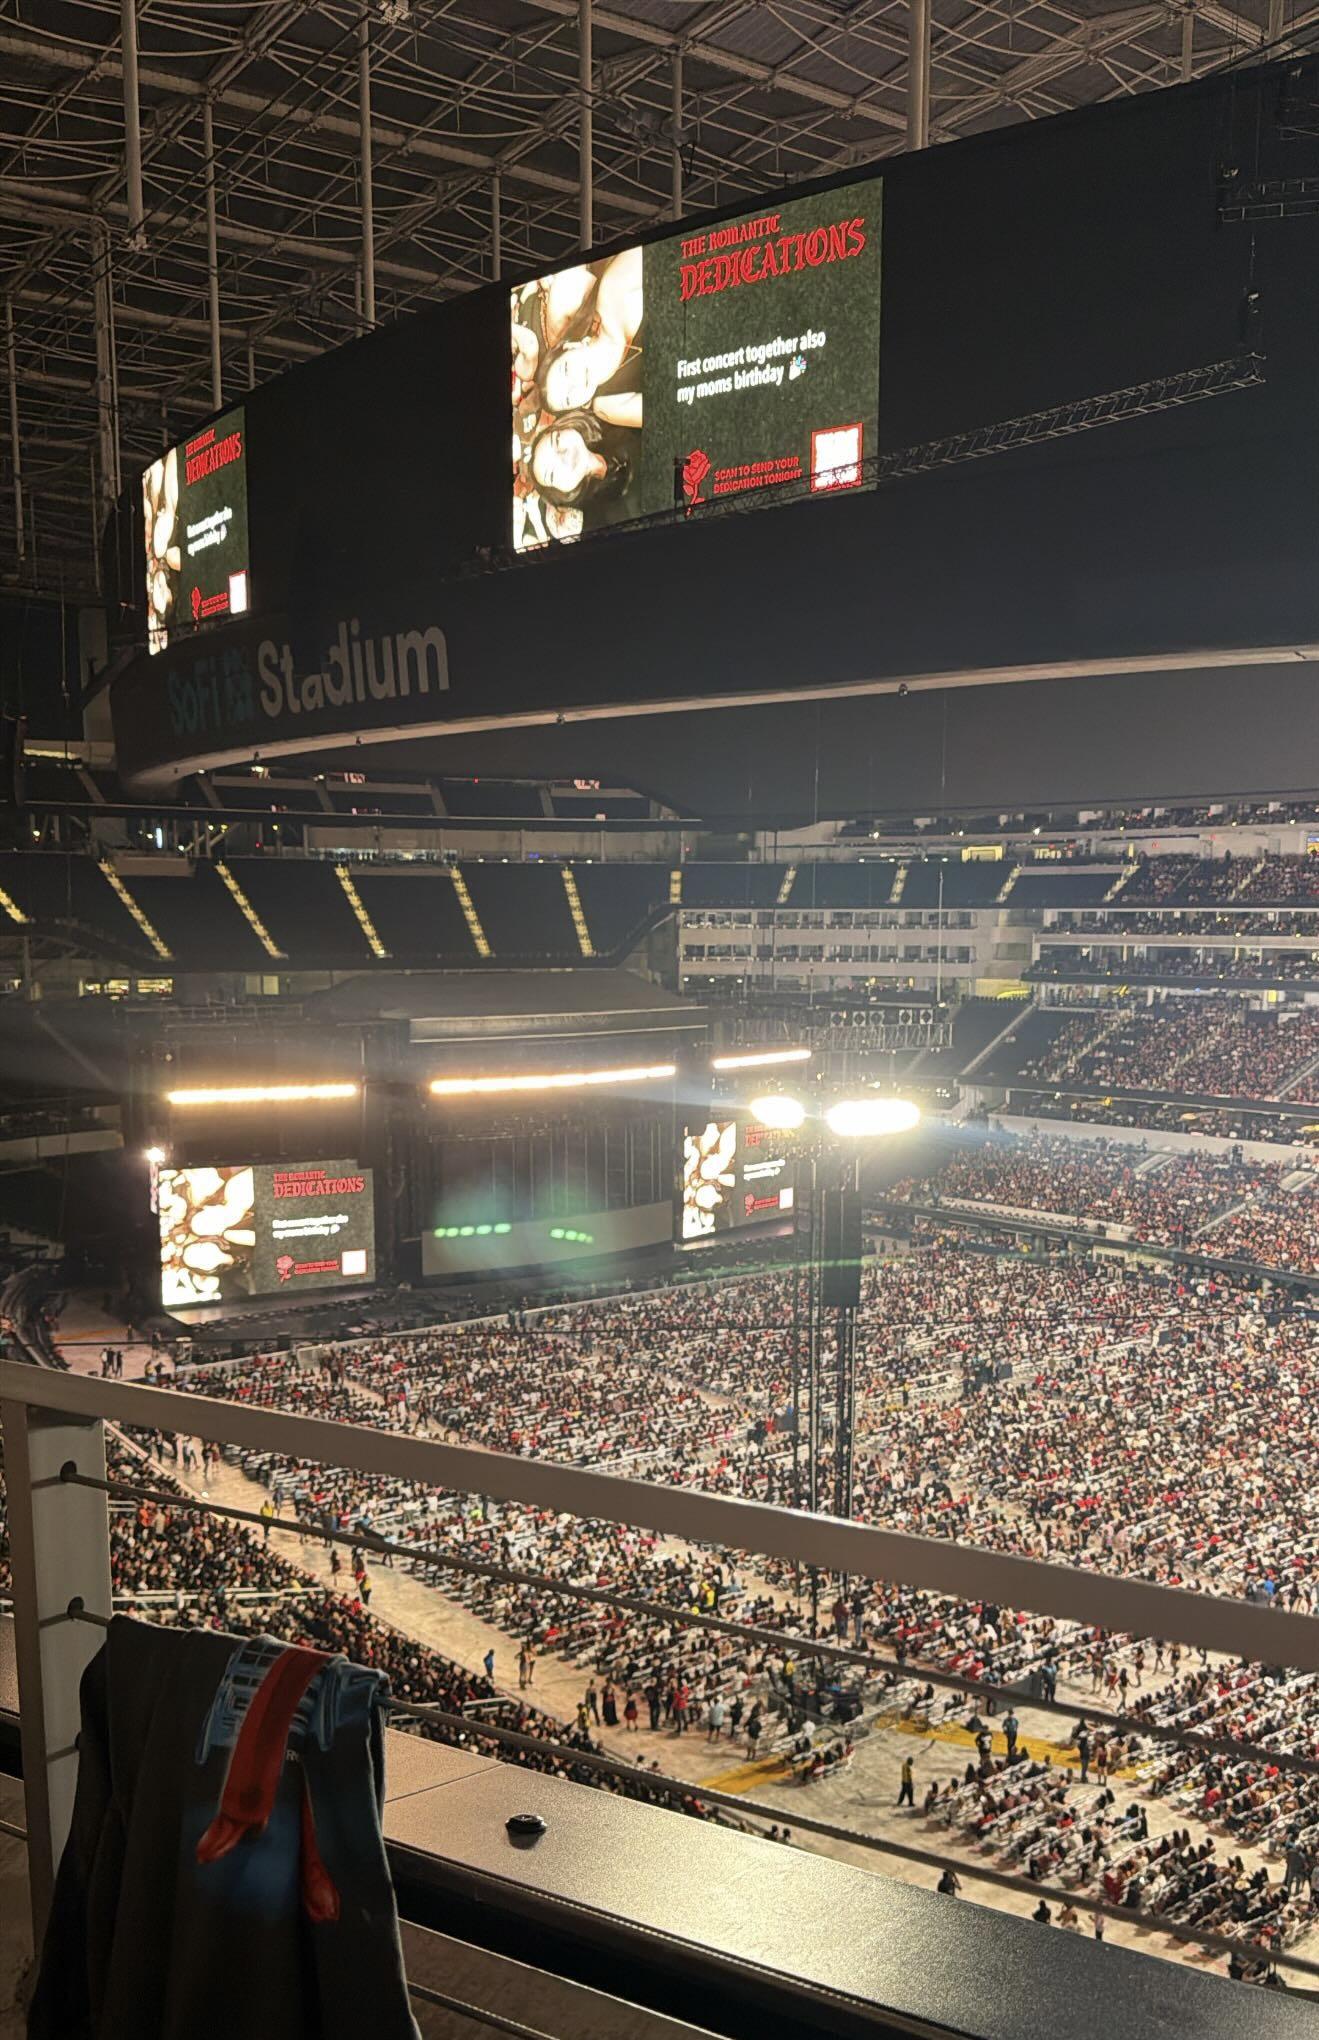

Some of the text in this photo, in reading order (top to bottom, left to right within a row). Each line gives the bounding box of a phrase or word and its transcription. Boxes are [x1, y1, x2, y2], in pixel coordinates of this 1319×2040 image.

[680, 214, 782, 259] THE ROMANTIC
[679, 218, 866, 302] DEDICATIONS
[677, 328, 826, 379] First concert together also
[676, 363, 784, 406] my moms birthday
[185, 432, 242, 486] DEDICATIONS
[713, 468, 802, 494] DEDICATION TONIGHT
[714, 456, 799, 481] SCAN TO SEND YOUR
[257, 617, 450, 718] Stadium
[273, 1177, 365, 1199] DEDICATIONS
